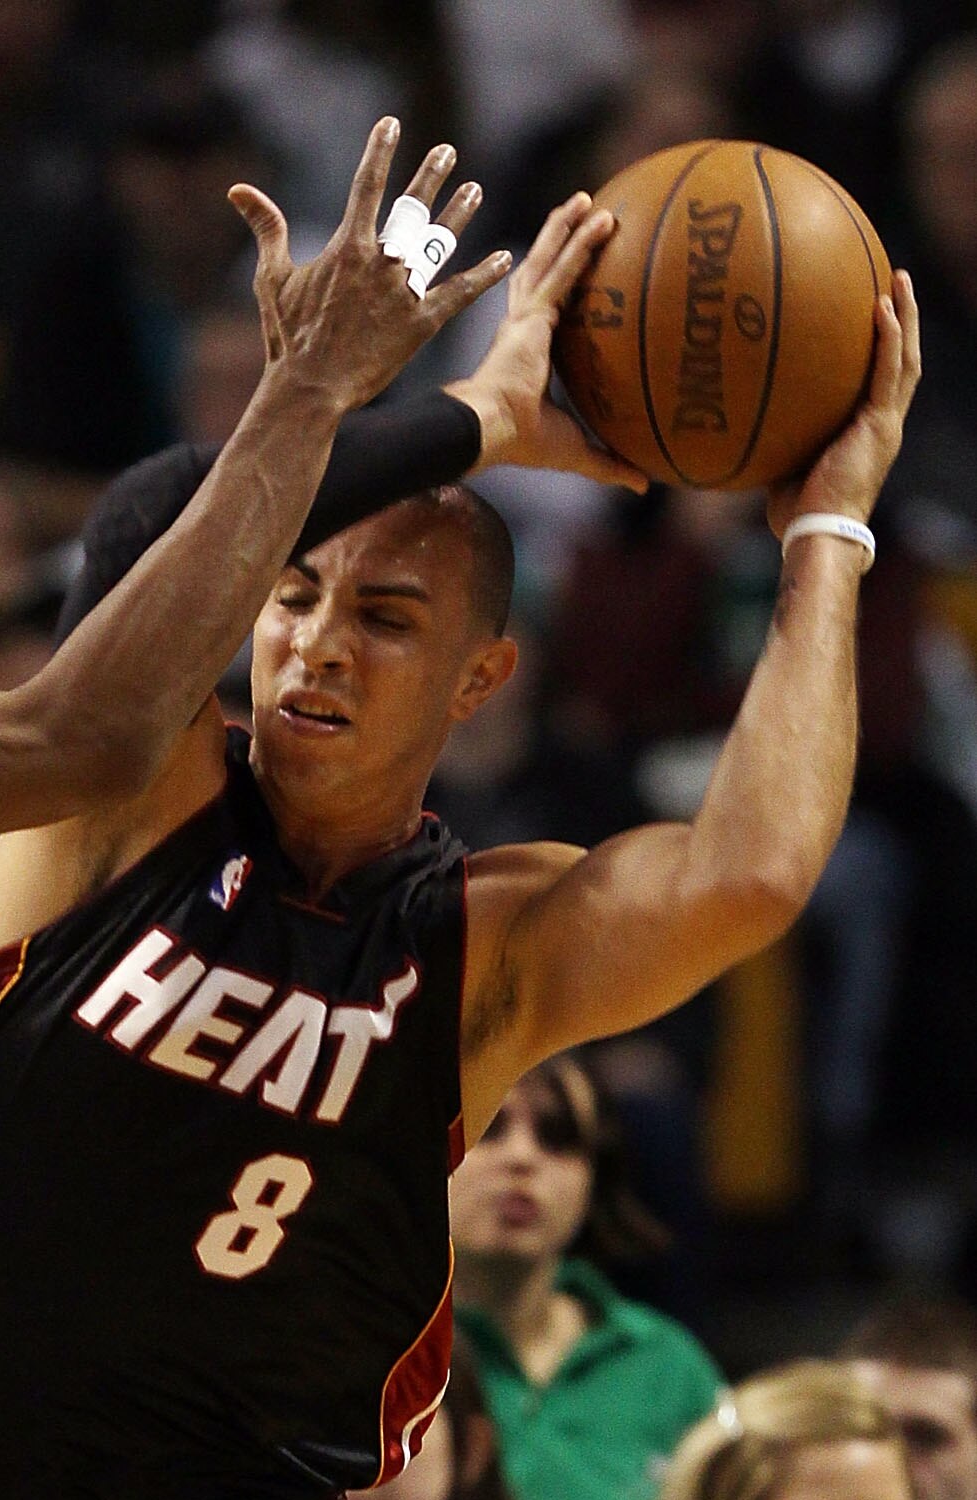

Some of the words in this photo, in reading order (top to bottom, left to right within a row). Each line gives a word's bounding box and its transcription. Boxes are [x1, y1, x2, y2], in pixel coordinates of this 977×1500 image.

[675, 199, 742, 432] SPALDING
[74, 926, 419, 1125] HEAT
[195, 1152, 313, 1280] 8
